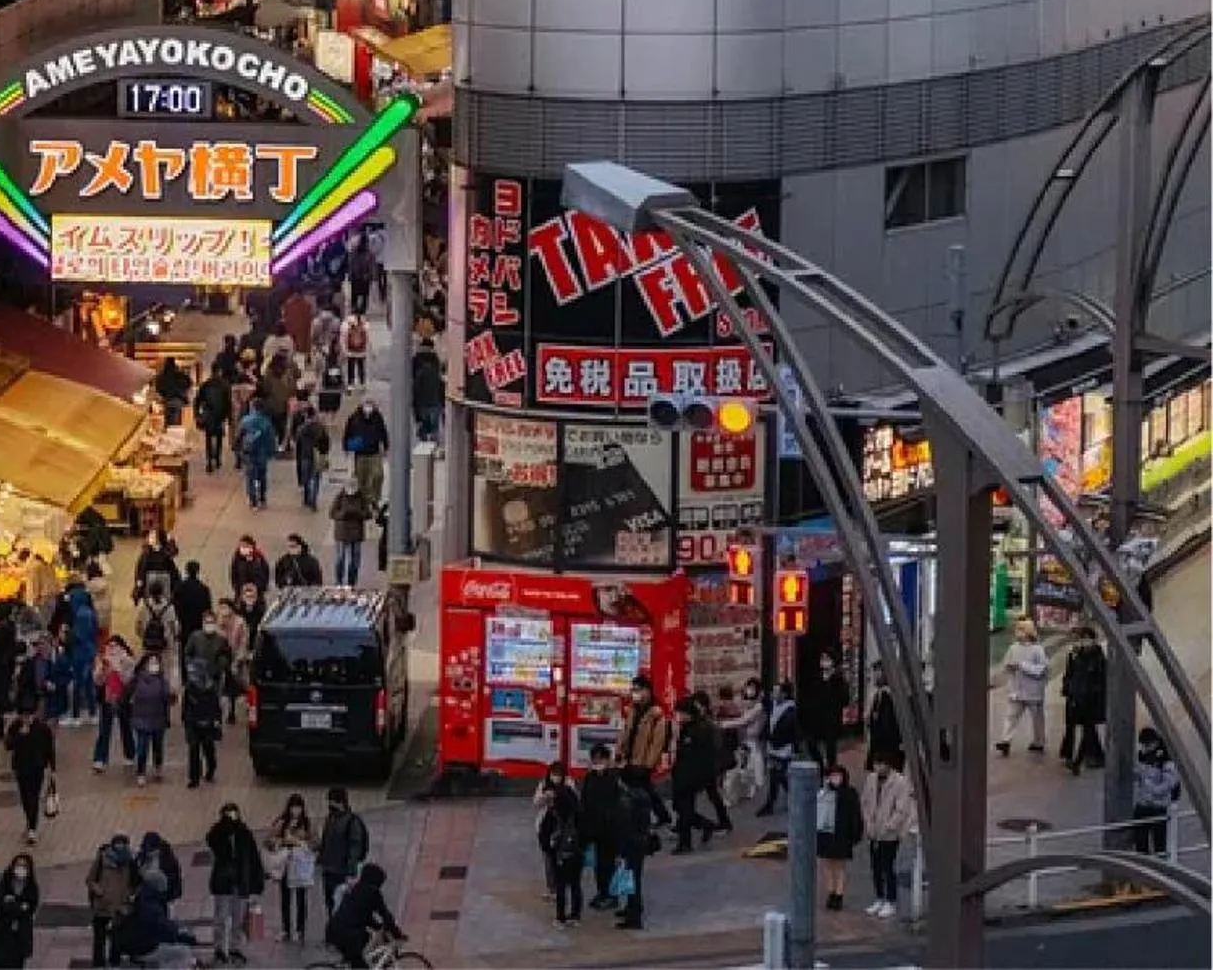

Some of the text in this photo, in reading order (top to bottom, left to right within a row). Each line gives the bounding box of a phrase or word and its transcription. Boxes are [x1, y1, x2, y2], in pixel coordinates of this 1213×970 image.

[24, 37, 310, 101] AMEYAYOKOCHO
[129, 84, 202, 113] 17:00
[29, 139, 318, 203] アメヤ横丁
